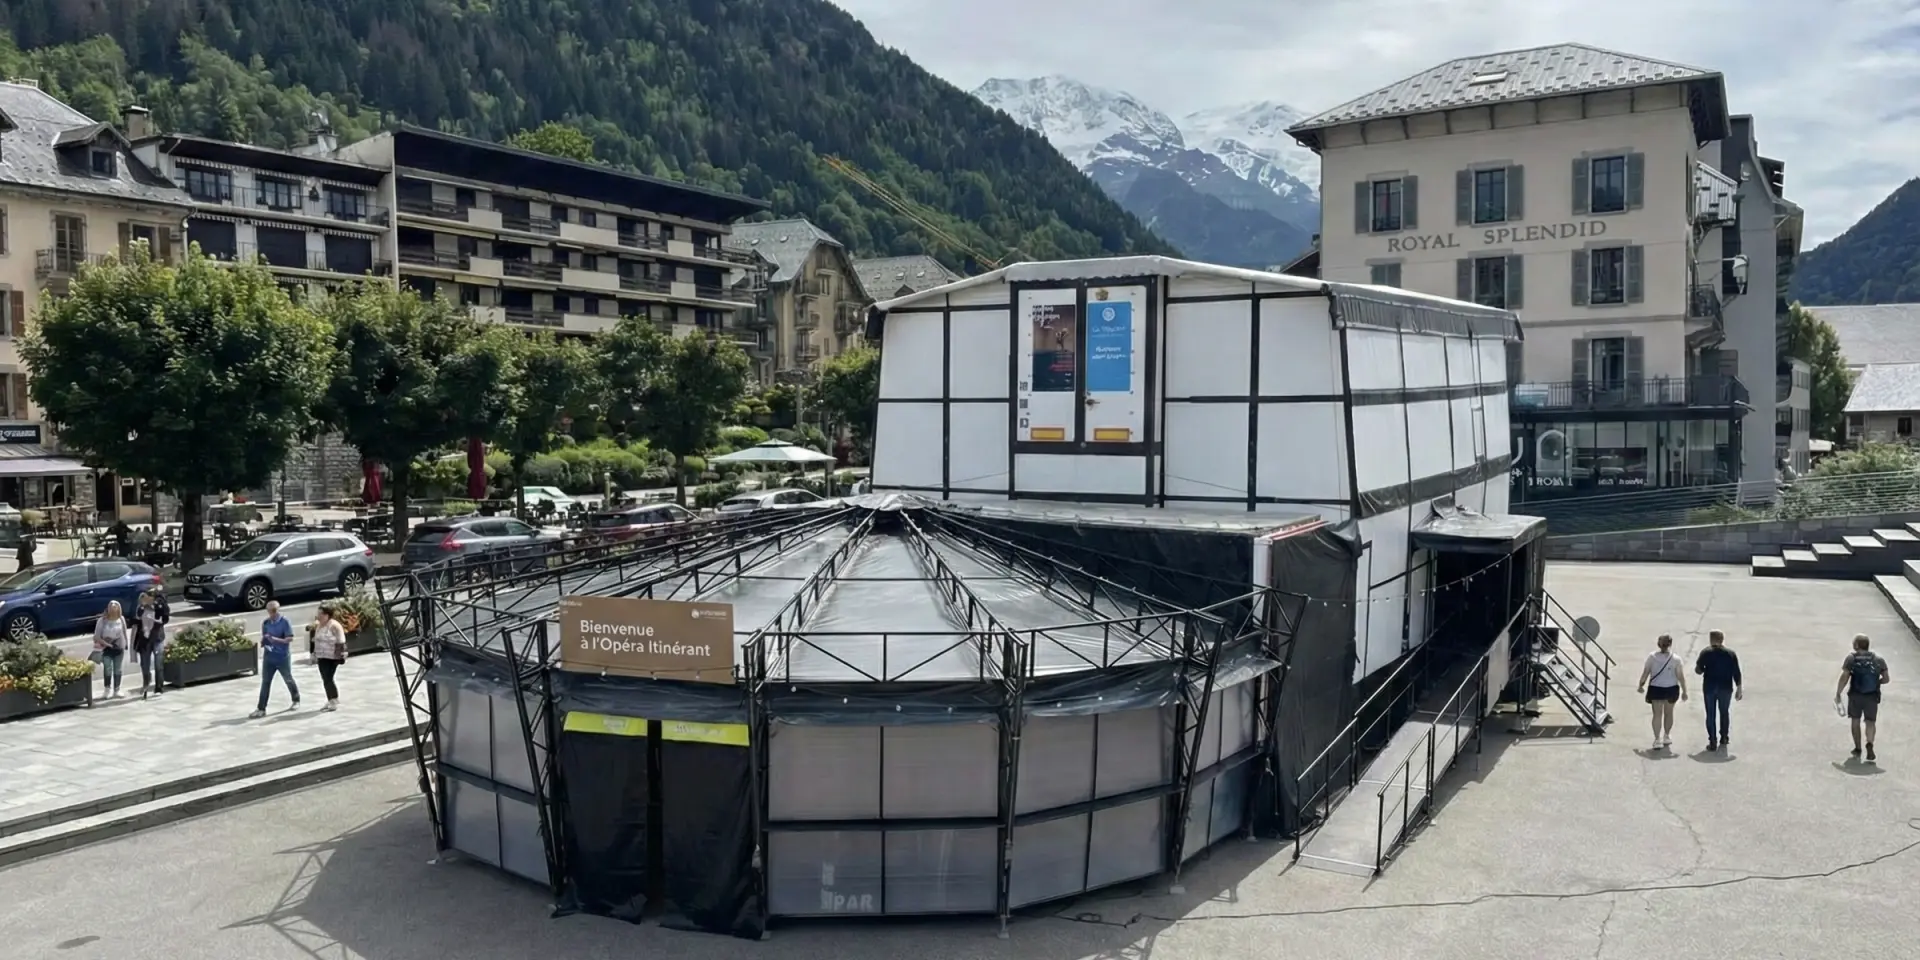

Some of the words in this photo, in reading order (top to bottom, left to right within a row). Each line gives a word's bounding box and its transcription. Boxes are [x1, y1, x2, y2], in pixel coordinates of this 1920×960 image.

[1387, 233, 1460, 252] ROYAL
[1483, 220, 1607, 245] SPLENDID
[580, 619, 654, 637] Bienvenue
[580, 636, 589, 650] à
[592, 637, 645, 654] l'Opéra
[648, 640, 711, 657] Itinérant
